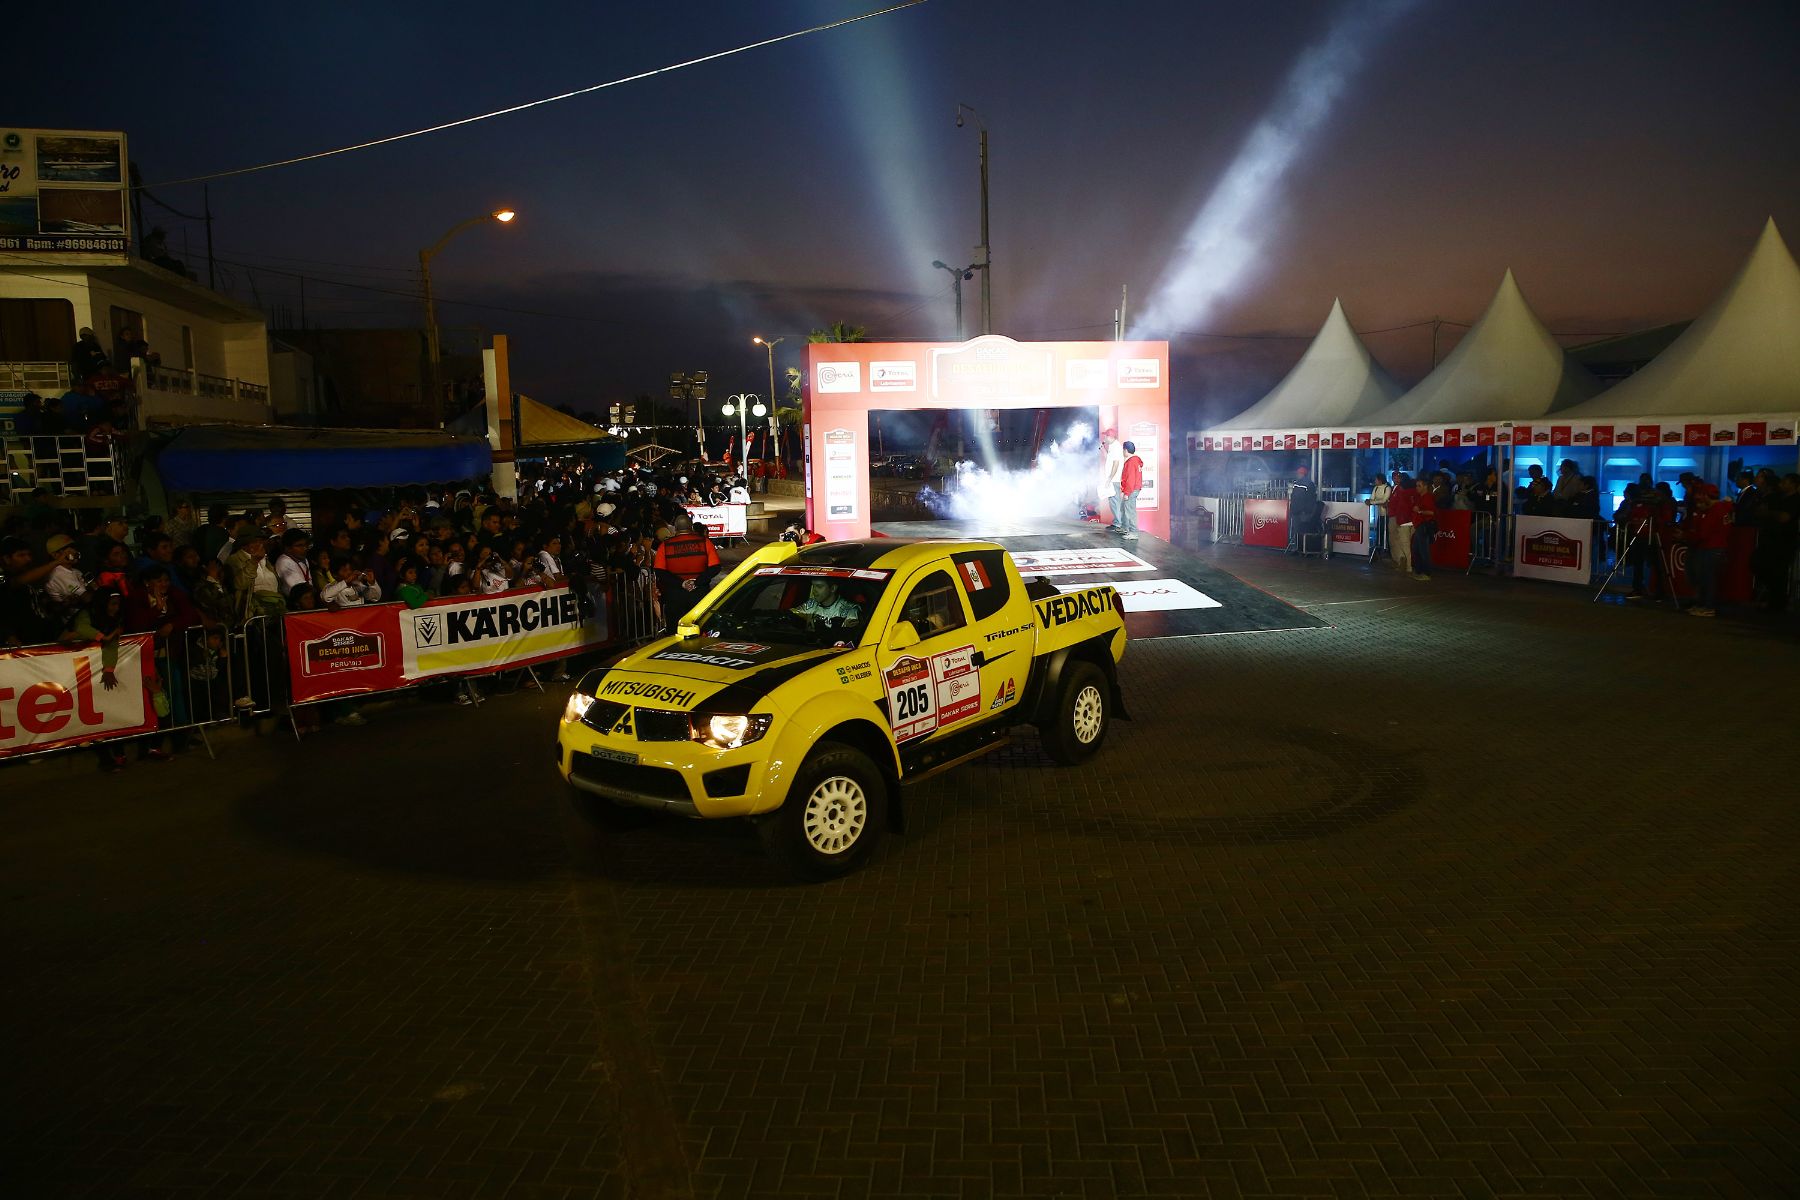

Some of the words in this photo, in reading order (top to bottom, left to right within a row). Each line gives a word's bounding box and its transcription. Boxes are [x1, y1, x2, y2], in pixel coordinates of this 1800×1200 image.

[1035, 587, 1112, 629] VEDACIT
[446, 594, 583, 643] KÄRCHE
[983, 626, 1019, 642] Triton
[352, 644, 370, 653] INCA
[653, 651, 756, 668] VEDACIT
[951, 656, 967, 664] TOTAL
[600, 680, 696, 707] MITSUBISHI
[896, 684, 929, 721] 205
[941, 707, 959, 719] DAKAR
